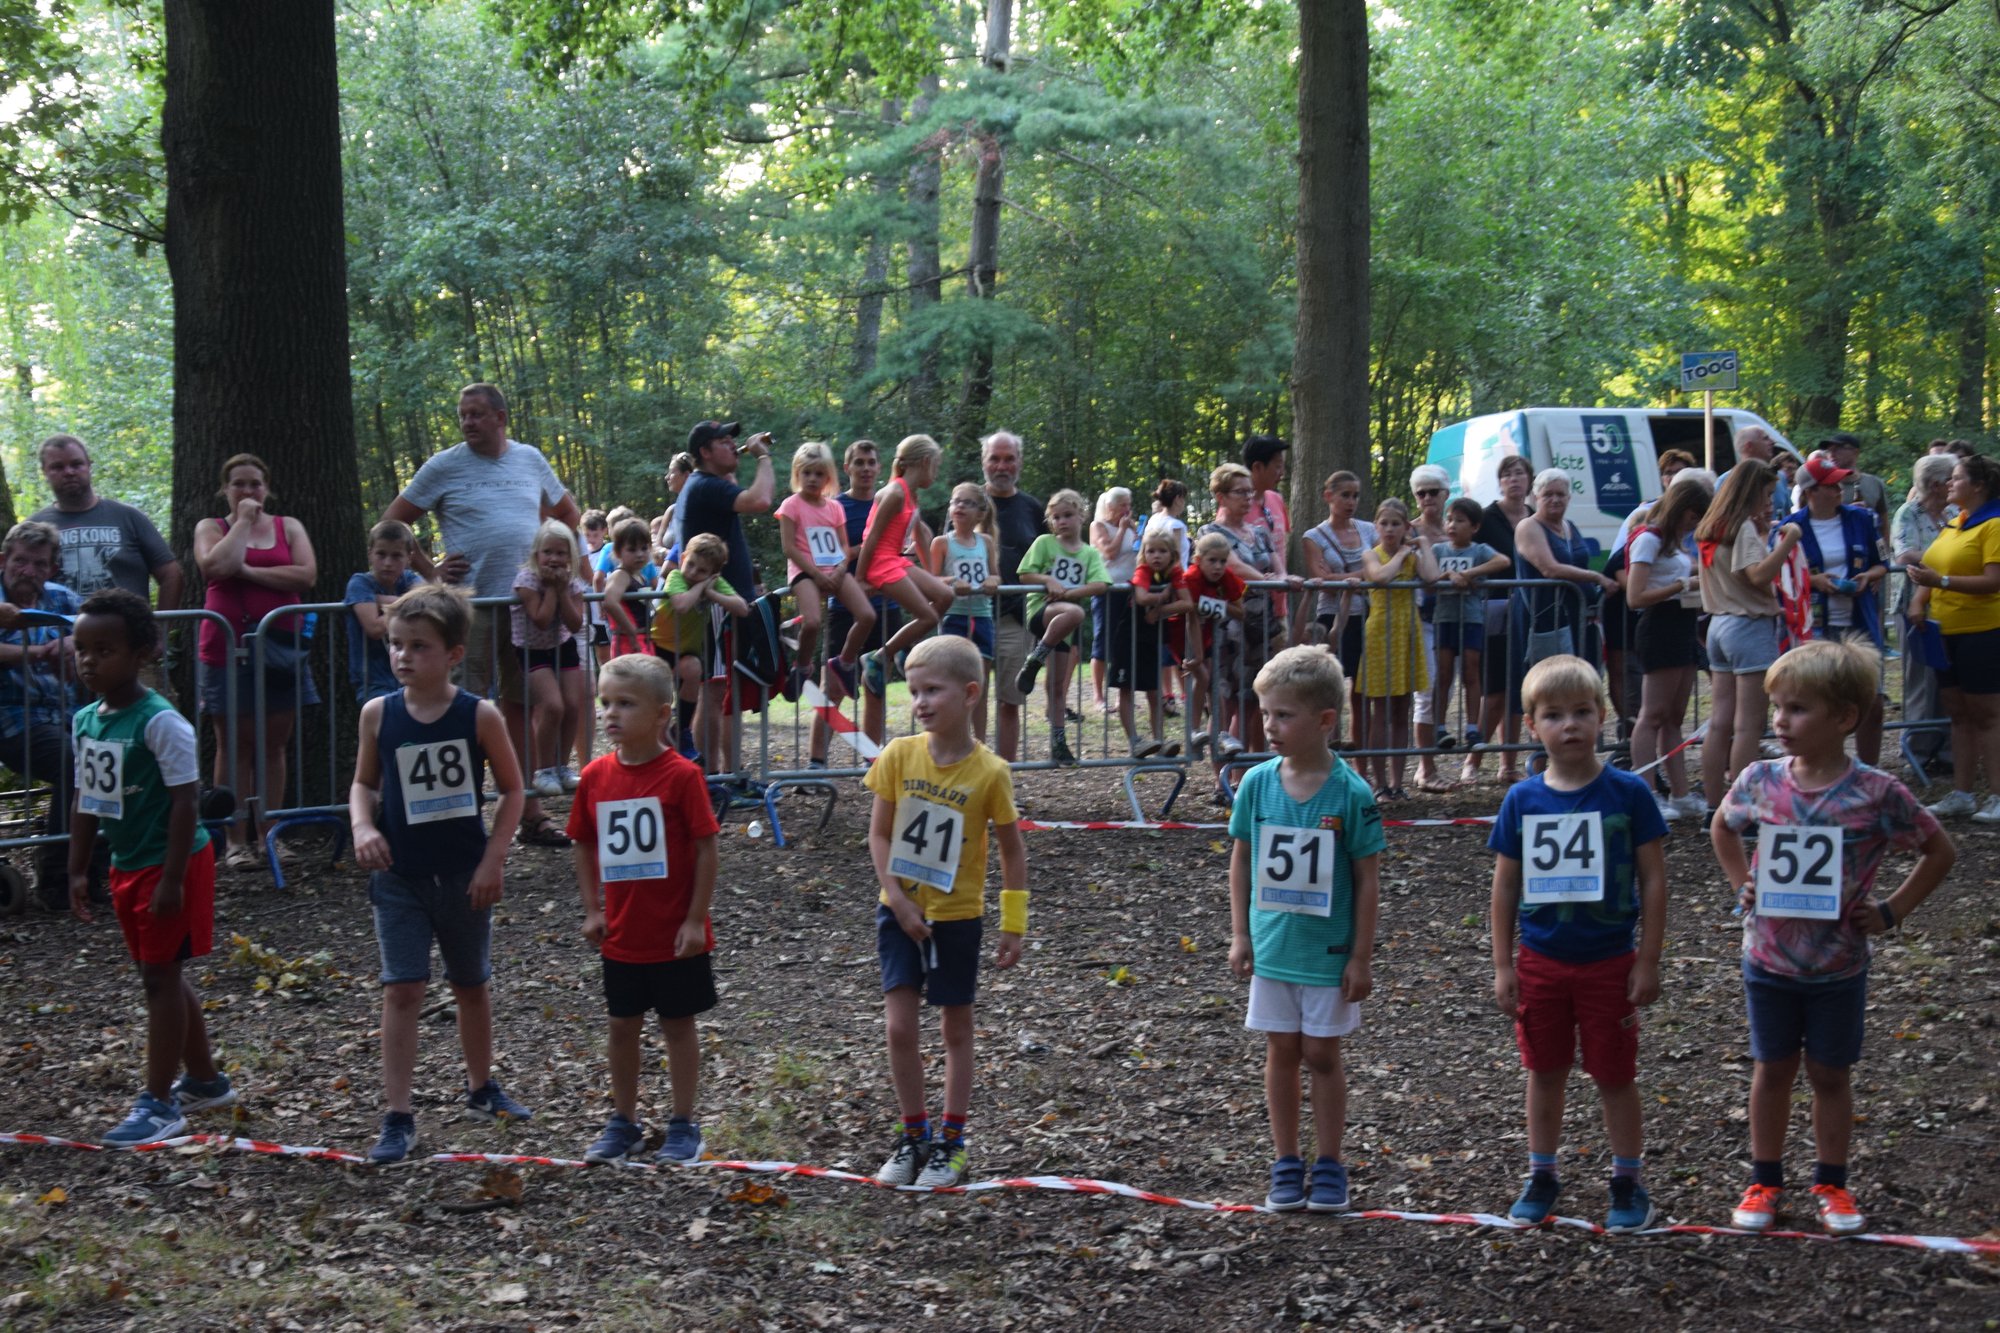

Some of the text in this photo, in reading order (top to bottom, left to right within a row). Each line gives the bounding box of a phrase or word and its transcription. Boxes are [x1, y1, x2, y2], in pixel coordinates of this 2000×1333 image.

[1683, 358, 1735, 381] TOOG
[1591, 423, 1625, 454] 50
[59, 528, 120, 545] NG KONG
[811, 531, 836, 553] 10
[959, 562, 985, 584] 88
[1056, 558, 1083, 585] 83
[84, 749, 116, 793] 53
[408, 745, 465, 791] 48
[607, 807, 657, 855] 50
[902, 810, 955, 863] 41
[1532, 819, 1595, 871] 54
[1266, 834, 1320, 884] 51
[1769, 833, 1833, 885] 52
